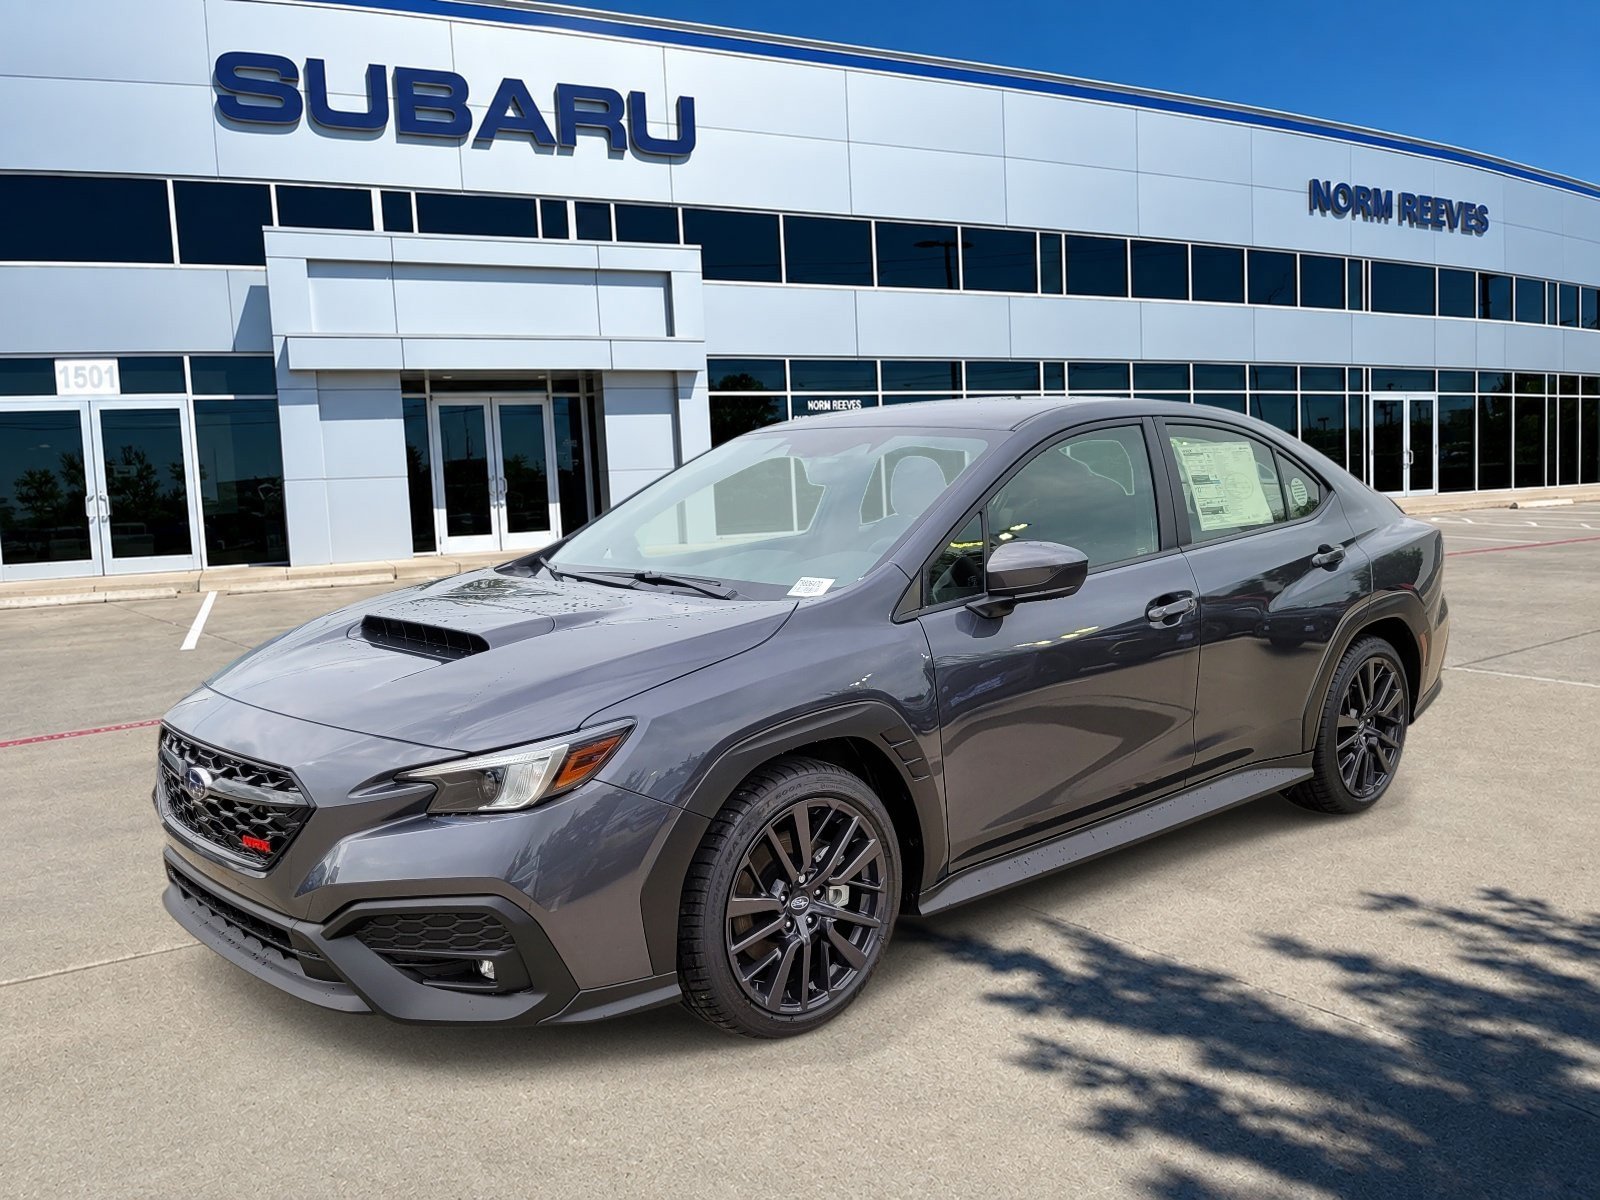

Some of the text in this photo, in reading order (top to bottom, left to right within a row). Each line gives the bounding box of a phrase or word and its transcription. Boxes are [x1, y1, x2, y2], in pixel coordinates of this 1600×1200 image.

[214, 51, 696, 157] SUBARU
[1309, 178, 1489, 234] NORM REEVES
[58, 364, 115, 389] 1501
[807, 399, 862, 411] NORM REEVES
